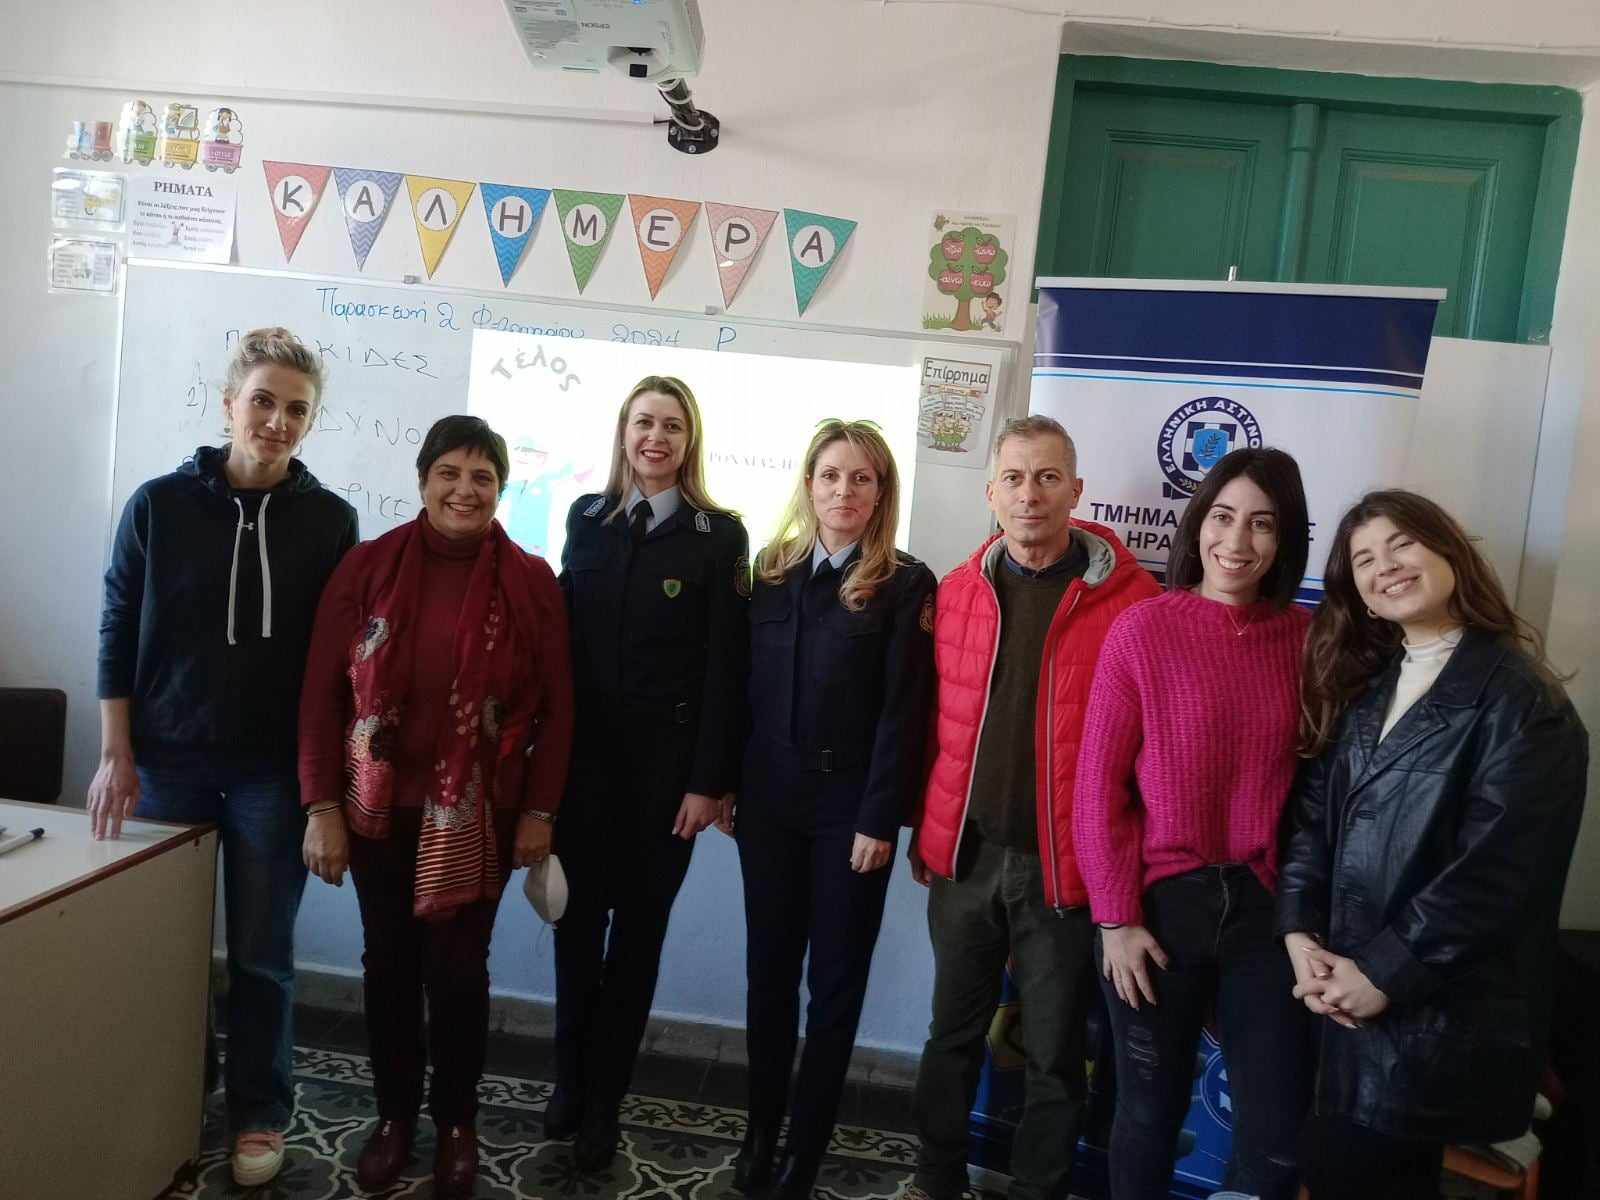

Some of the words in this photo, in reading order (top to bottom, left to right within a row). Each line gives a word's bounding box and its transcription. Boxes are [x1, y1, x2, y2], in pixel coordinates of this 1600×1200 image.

[153, 181, 213, 198] ΡΗΜΑΤΑ
[281, 180, 824, 264] ΚΑΛΗΜΕΡΑ
[316, 287, 427, 324] Παρασκευή
[437, 302, 461, 331] 2
[490, 343, 581, 392] Τέλος
[924, 360, 988, 385] Επίρρημα
[1162, 400, 1208, 474] ΕΛΛΗΝΙΚΗ
[1213, 399, 1261, 448] ΑΣΤΥΝΟ
[1090, 503, 1178, 528] ΤΜΗΜΑ
[1126, 530, 1171, 551] ΗΡΑ
